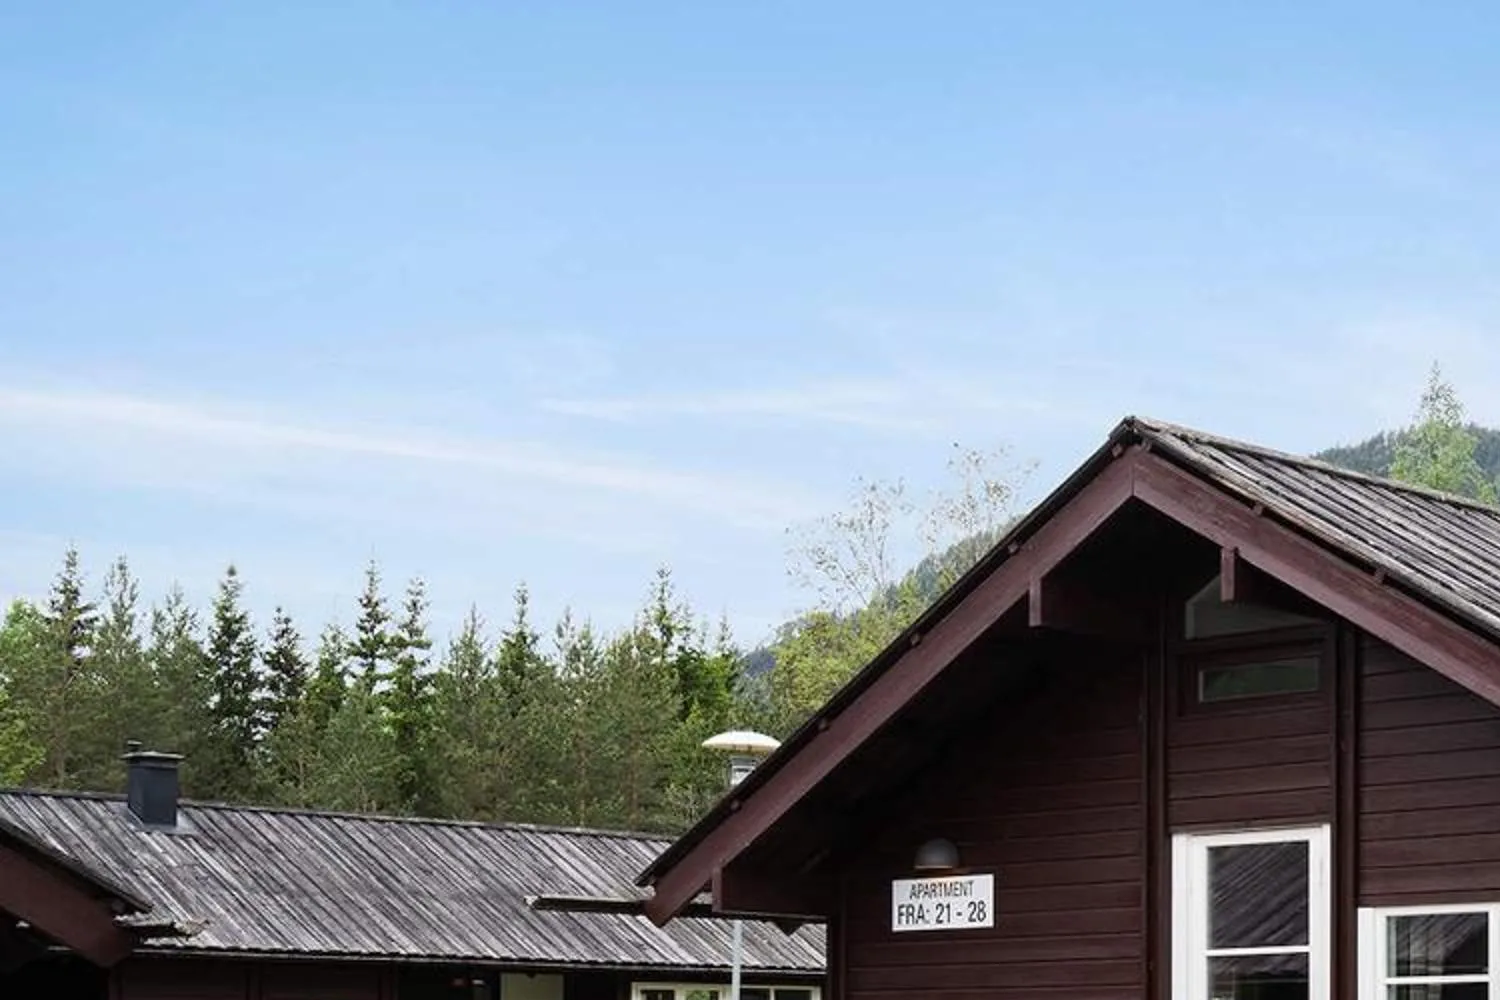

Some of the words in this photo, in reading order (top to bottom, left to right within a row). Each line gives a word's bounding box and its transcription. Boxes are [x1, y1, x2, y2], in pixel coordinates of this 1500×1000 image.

[909, 880, 974, 899] APARTMENT
[935, 903, 951, 924] 21
[967, 900, 987, 923] 28
